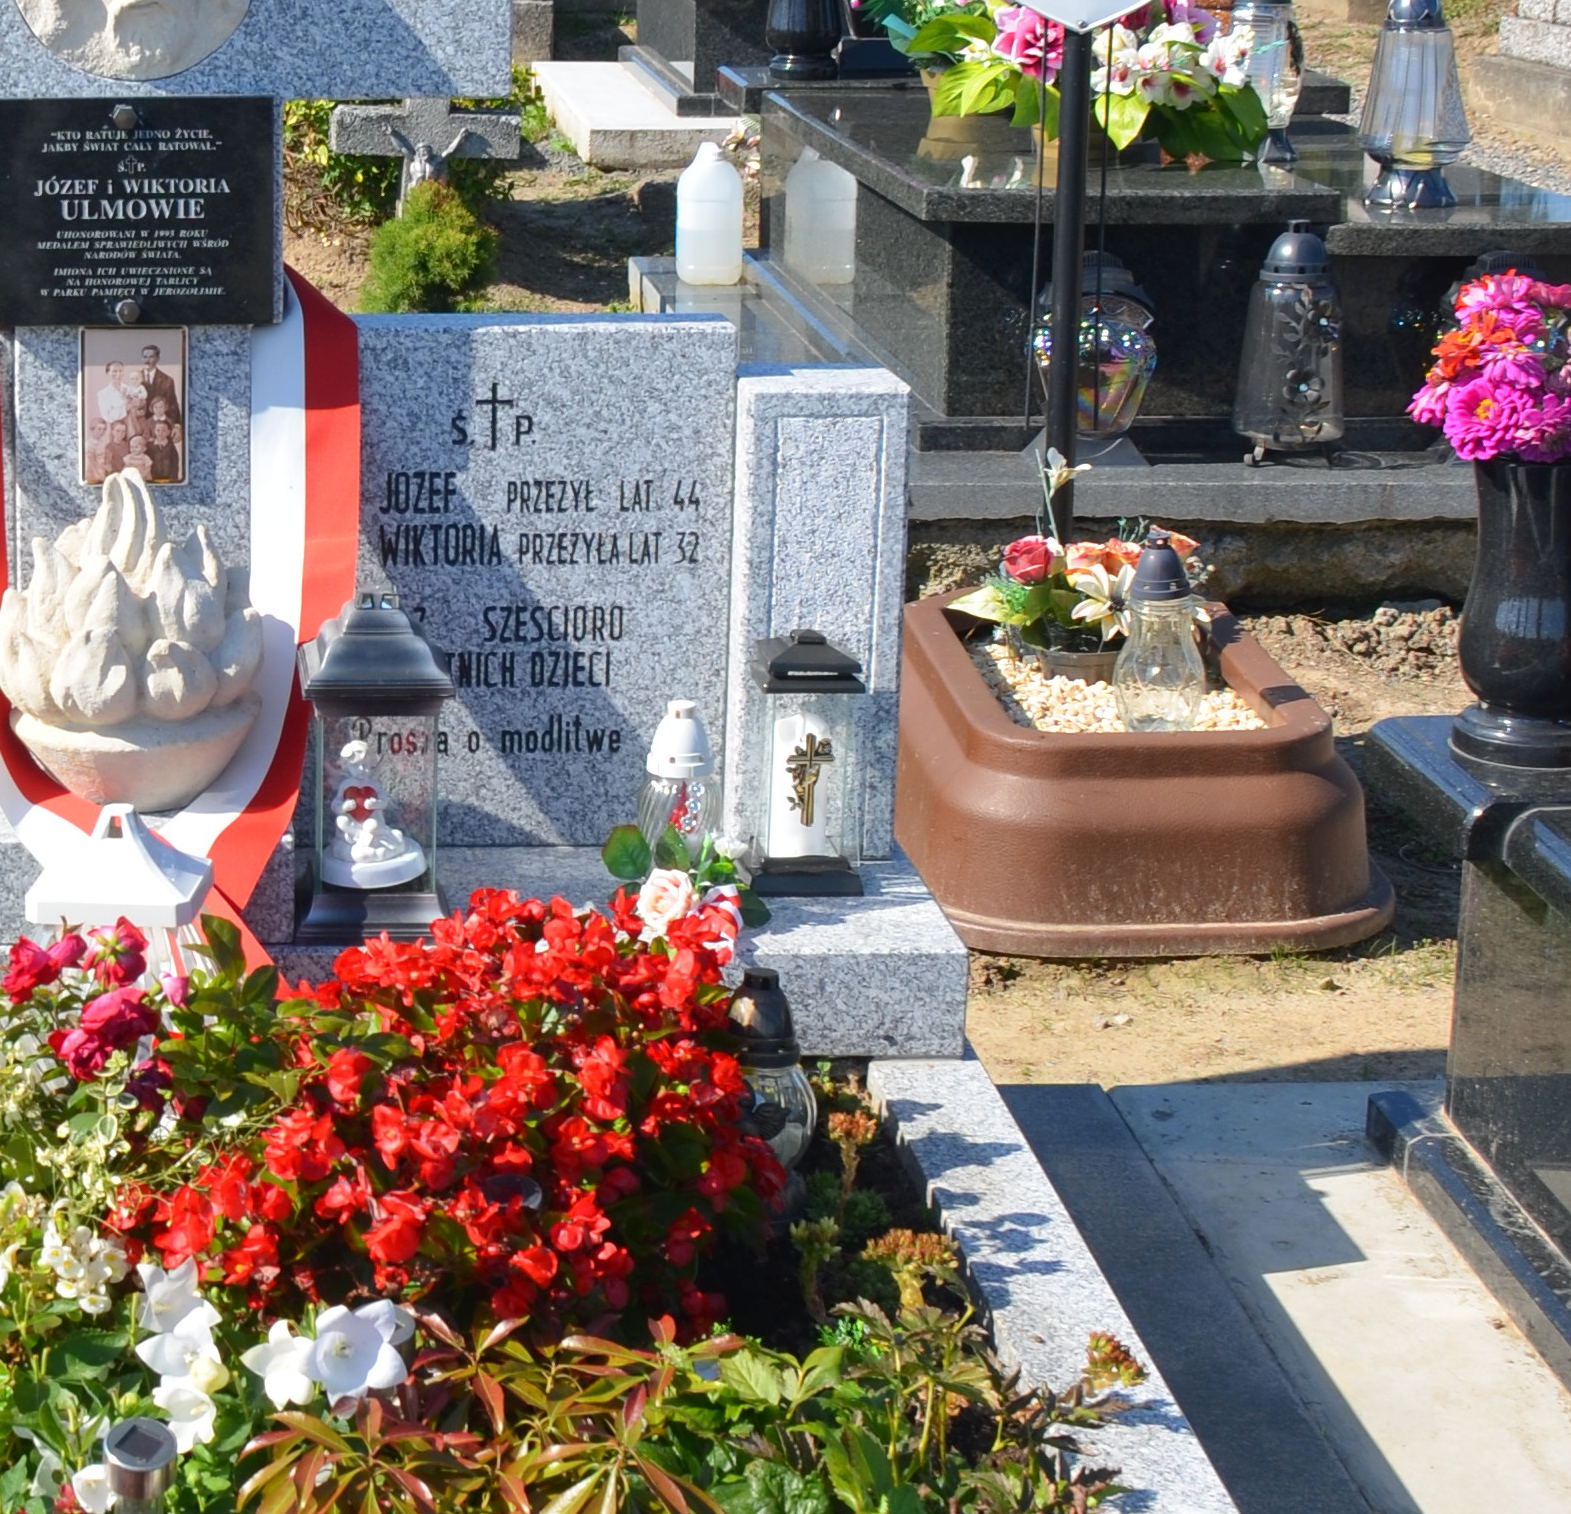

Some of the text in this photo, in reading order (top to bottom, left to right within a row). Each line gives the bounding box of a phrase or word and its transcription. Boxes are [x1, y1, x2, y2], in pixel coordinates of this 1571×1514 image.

[132, 128, 171, 141] JEDNO
[41, 142, 79, 153] JAKBY
[83, 140, 120, 152] ŚWIAT
[33, 175, 231, 197] JÓZEF i WIKTORIA
[59, 198, 206, 221] ULMOWIE
[55, 230, 136, 240] UHONOROWANI
[140, 229, 151, 239] W
[179, 229, 209, 238] ROKU
[36, 237, 230, 250] MEDALEM SPRAWIEDLIWYCH WŚRÓD
[83, 249, 137, 260] NARODÓW
[53, 266, 213, 277] IMIONA ICH UWIECZNIONE SĄ
[65, 276, 200, 287] NA HONOROWEJ TABLICY
[40, 289, 50, 297] W
[52, 288, 88, 297] PARKU
[91, 287, 136, 298] PAMIĘCI
[140, 288, 149, 296] W
[515, 414, 537, 447] P.
[618, 479, 654, 513] LAT
[672, 479, 701, 513] 44
[378, 522, 503, 568] WIKTORIA
[628, 531, 663, 566] LAT
[674, 531, 700, 565] 32
[443, 649, 612, 689] TNICH DZIECI
[467, 729, 481, 755] o
